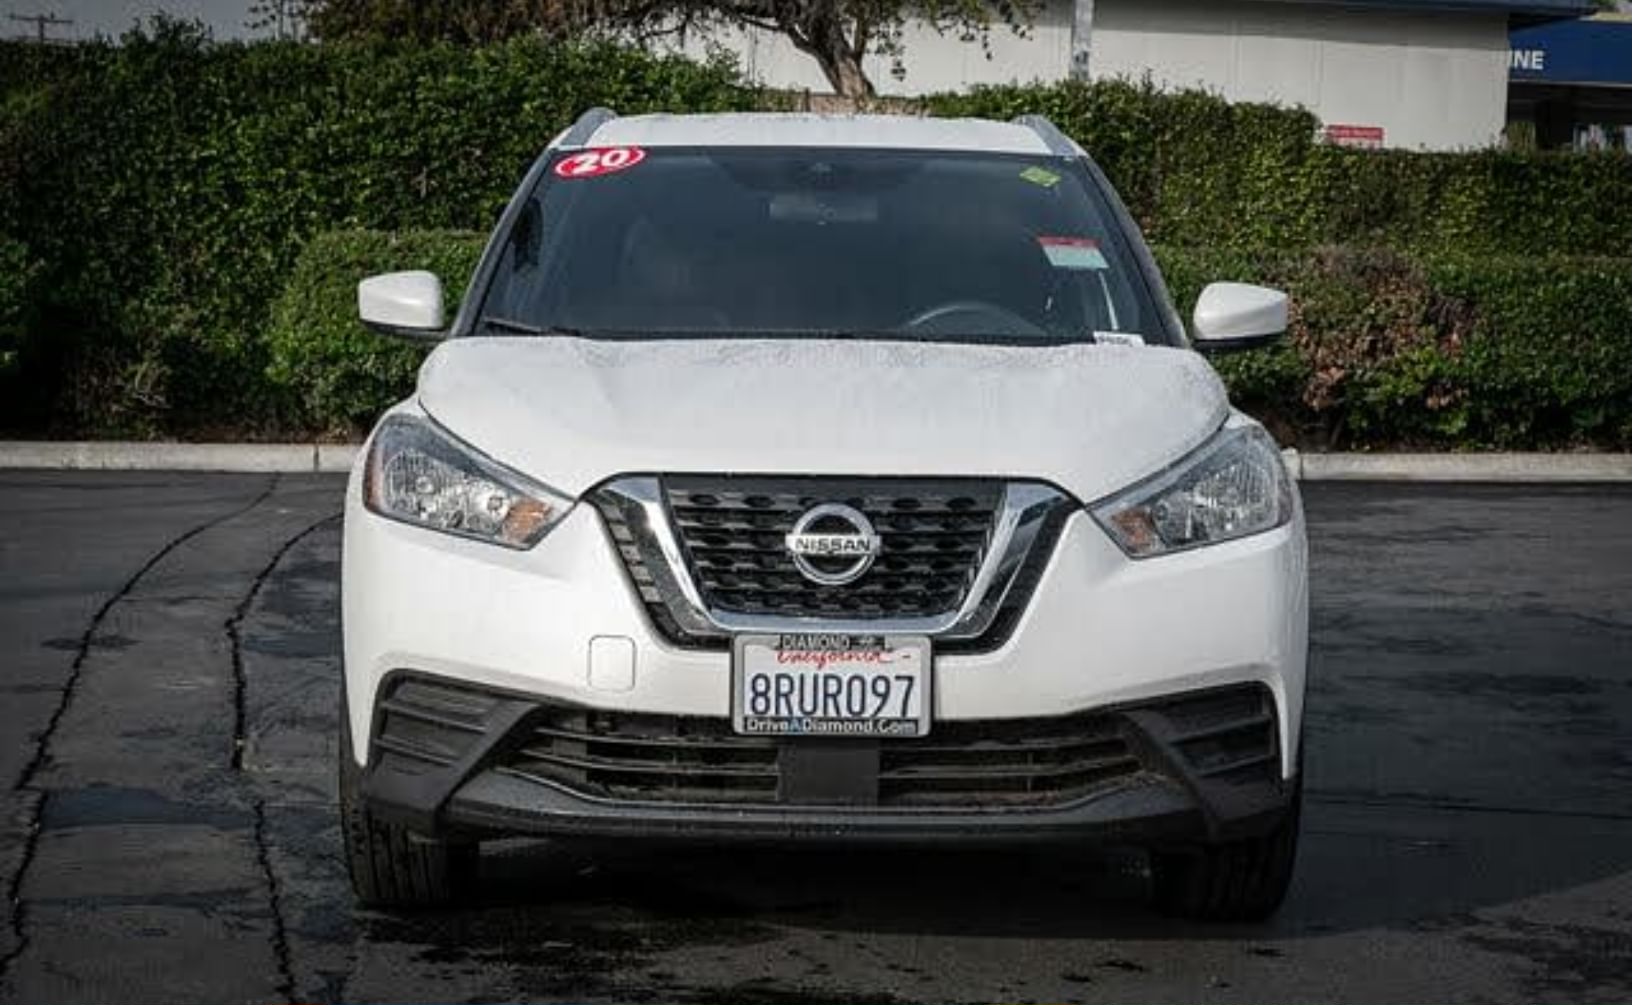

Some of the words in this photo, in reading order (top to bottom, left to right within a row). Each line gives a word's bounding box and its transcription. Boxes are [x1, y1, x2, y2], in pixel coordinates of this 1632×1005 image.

[571, 150, 630, 174] 20
[796, 539, 871, 552] NISSAN
[783, 635, 850, 650] DIAMOND
[751, 674, 914, 717] 8RUR097
